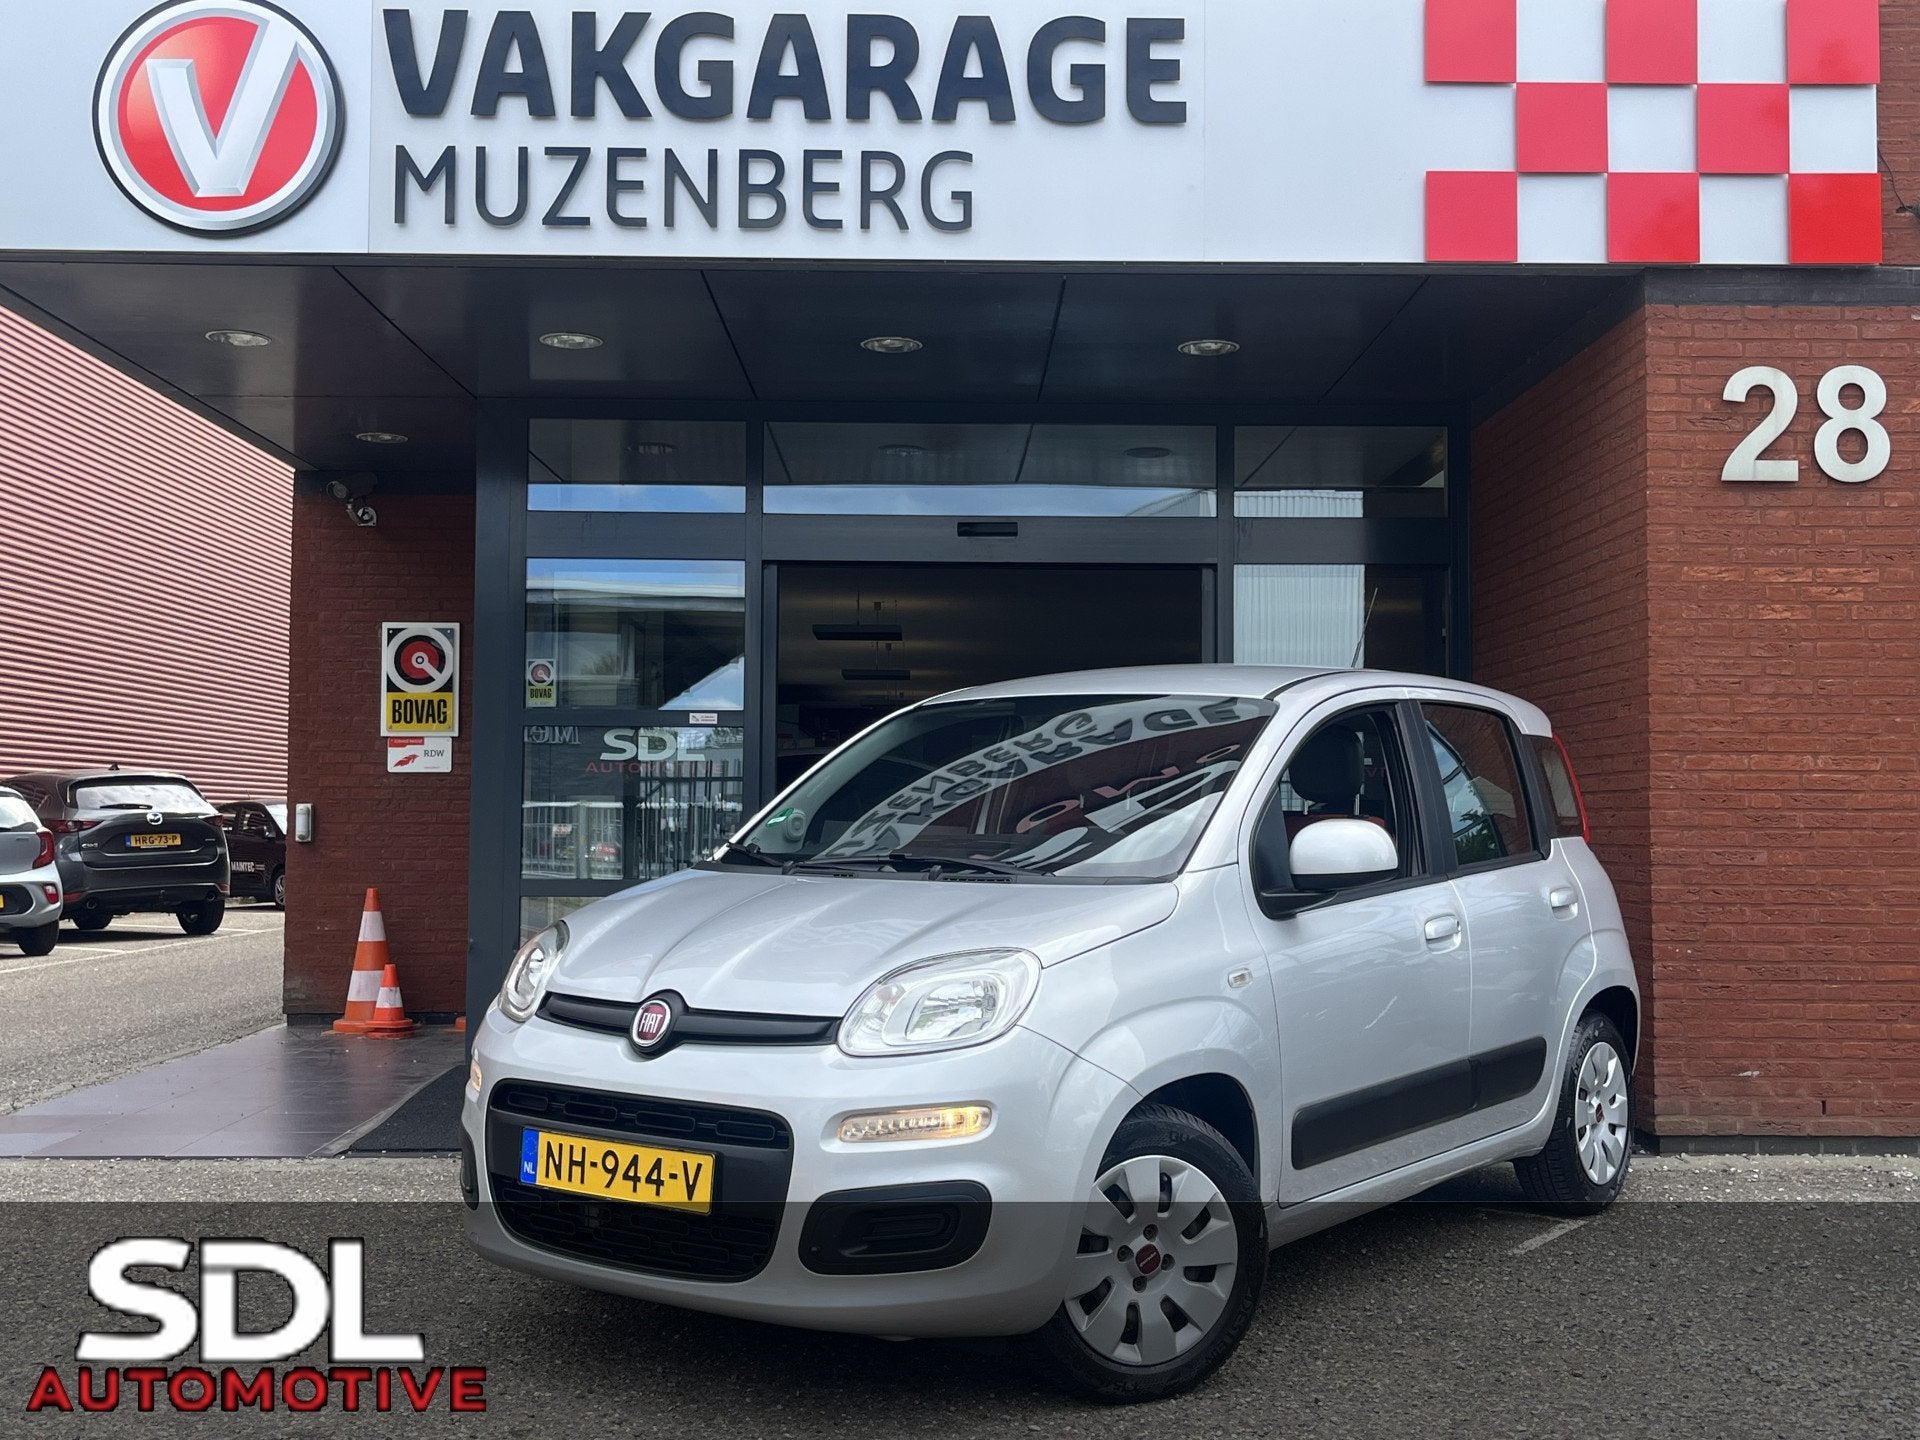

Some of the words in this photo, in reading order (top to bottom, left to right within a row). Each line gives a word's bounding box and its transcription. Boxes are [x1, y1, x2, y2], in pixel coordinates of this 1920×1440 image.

[383, 9, 1187, 125] VAKGARAGE
[393, 145, 974, 232] MUZENBERG
[1721, 365, 1891, 483] 28
[529, 688, 552, 699] BOVAG
[391, 699, 448, 725] BOVAG
[423, 749, 445, 758] RDW
[600, 728, 706, 761] SDL
[134, 834, 178, 846] HRG-73-P
[638, 1012, 664, 1034] FIAT
[523, 1161, 536, 1175] NL
[545, 1140, 703, 1201] NH-944-V
